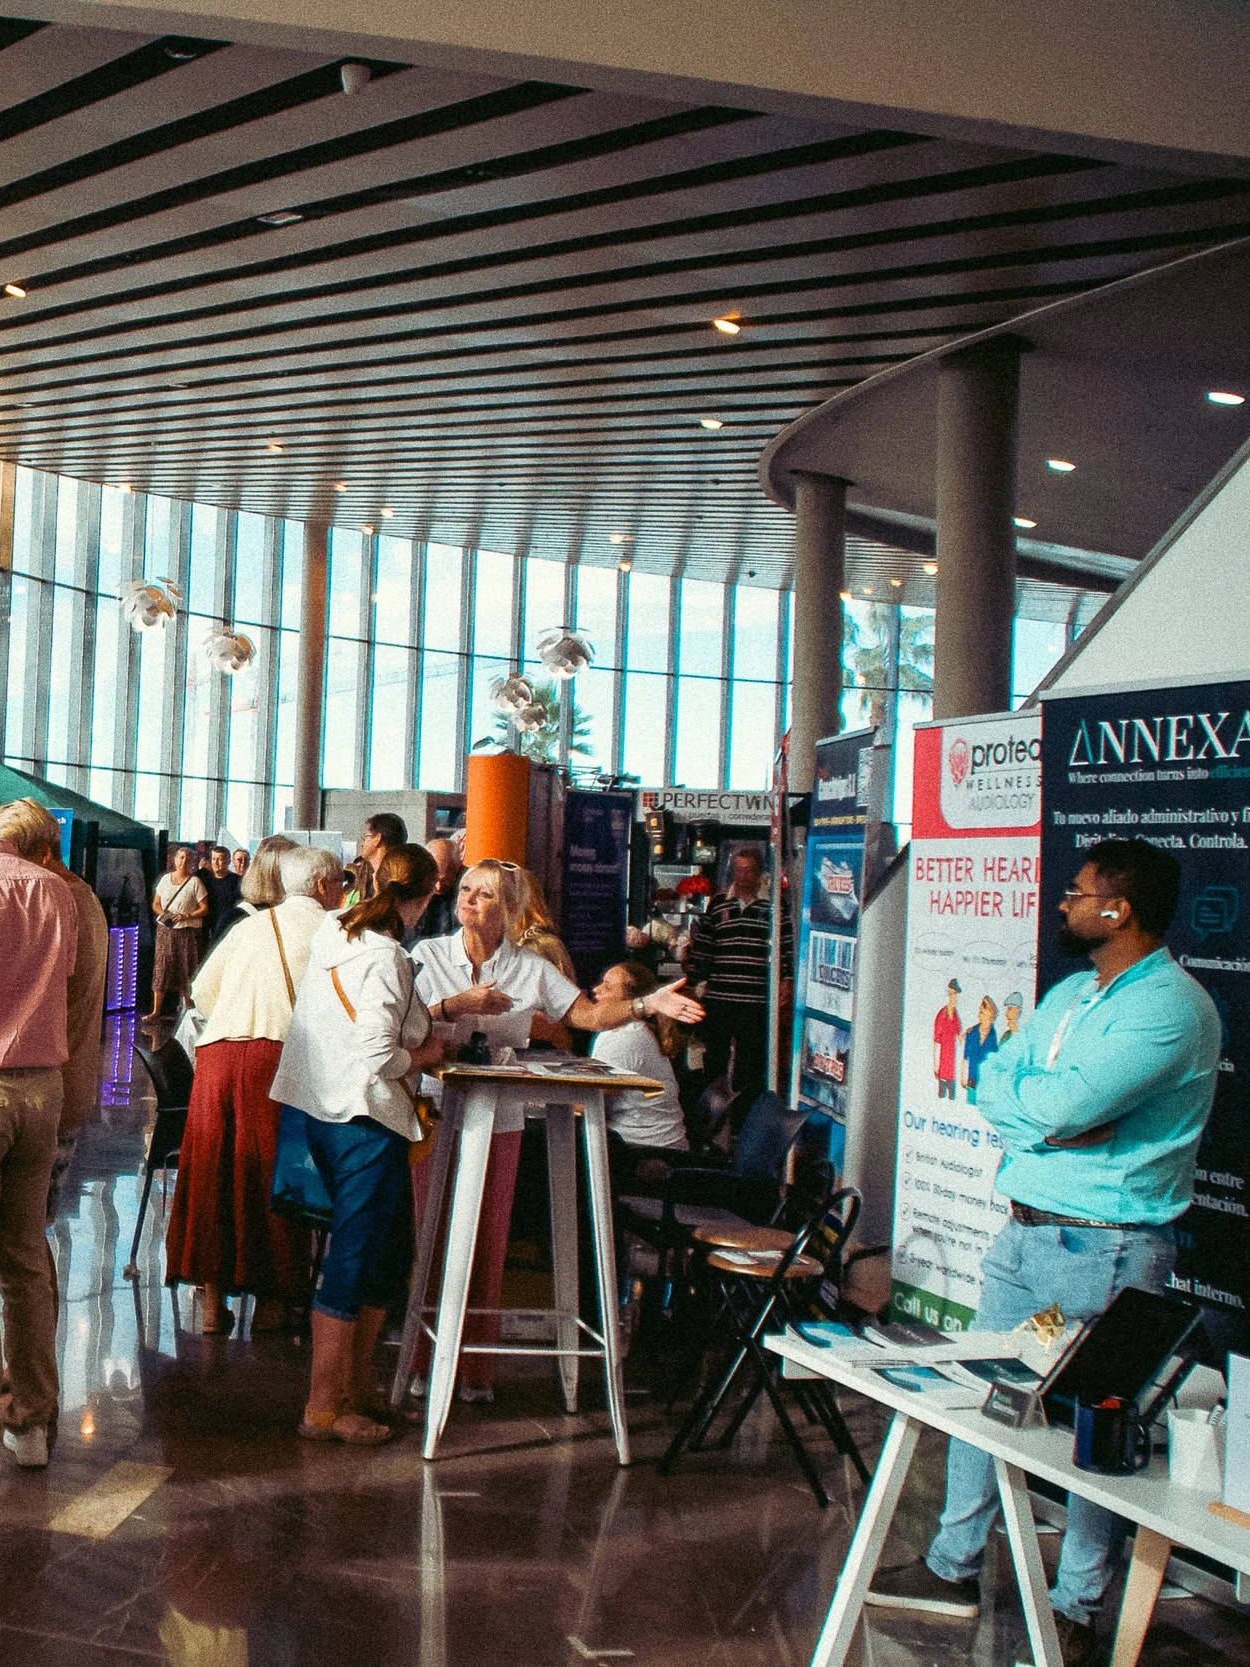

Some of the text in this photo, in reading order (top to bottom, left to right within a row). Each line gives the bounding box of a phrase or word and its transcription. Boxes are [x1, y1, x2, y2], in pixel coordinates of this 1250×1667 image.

[1102, 808, 1138, 824] aliado
[1141, 807, 1229, 825] administrativo
[1189, 832, 1248, 849] Controla.
[915, 857, 974, 883] BETTER
[929, 890, 1003, 918] HAPPIER
[904, 1110, 927, 1132] Our
[932, 1117, 982, 1148] hearing
[1165, 1271, 1193, 1293] hat
[894, 1291, 922, 1319] Call
[925, 1306, 940, 1326] us
